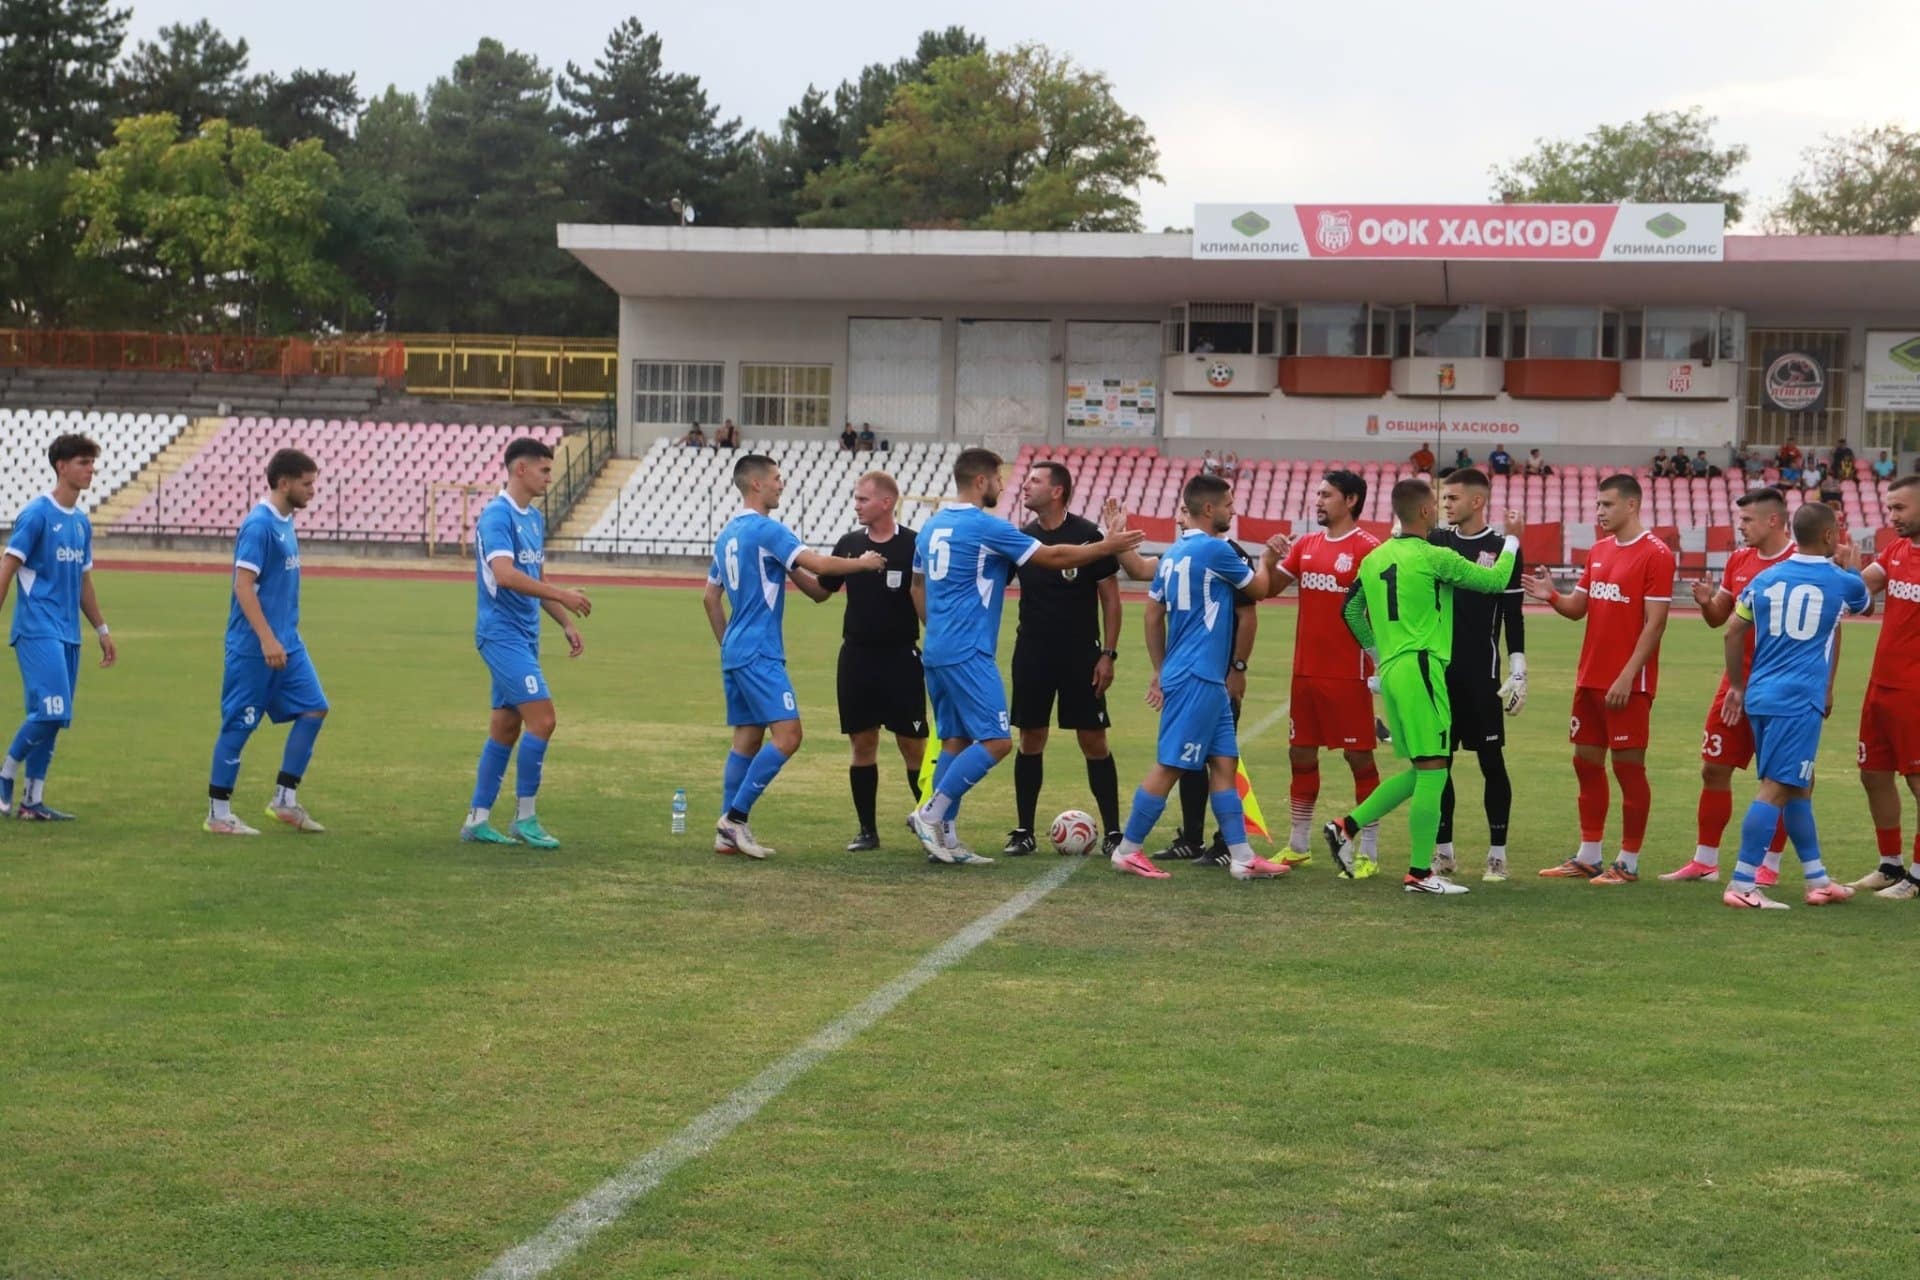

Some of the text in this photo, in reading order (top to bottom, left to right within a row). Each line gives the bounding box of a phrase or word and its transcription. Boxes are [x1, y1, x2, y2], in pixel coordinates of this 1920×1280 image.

[1359, 218, 1597, 247] ОФК ХАСКОВО
[1200, 242, 1299, 254] КЛИМАПОЛИС
[1613, 243, 1718, 255] КЛИМАПОЛИС
[1385, 420, 1520, 434] ОБЩИНА ХАСКОВО
[725, 537, 739, 591] 6
[928, 528, 954, 581] 5
[1159, 555, 1192, 612] 21
[1379, 563, 1400, 622] 1
[1763, 581, 1824, 641] 10
[525, 674, 540, 695] 9
[42, 695, 64, 715] 19
[783, 691, 795, 711] 6
[244, 706, 256, 725] 3
[998, 711, 1009, 731] 5
[1570, 715, 1581, 739] 9
[1438, 730, 1447, 750] 1
[1702, 731, 1723, 757] 23
[1180, 742, 1202, 763] 21
